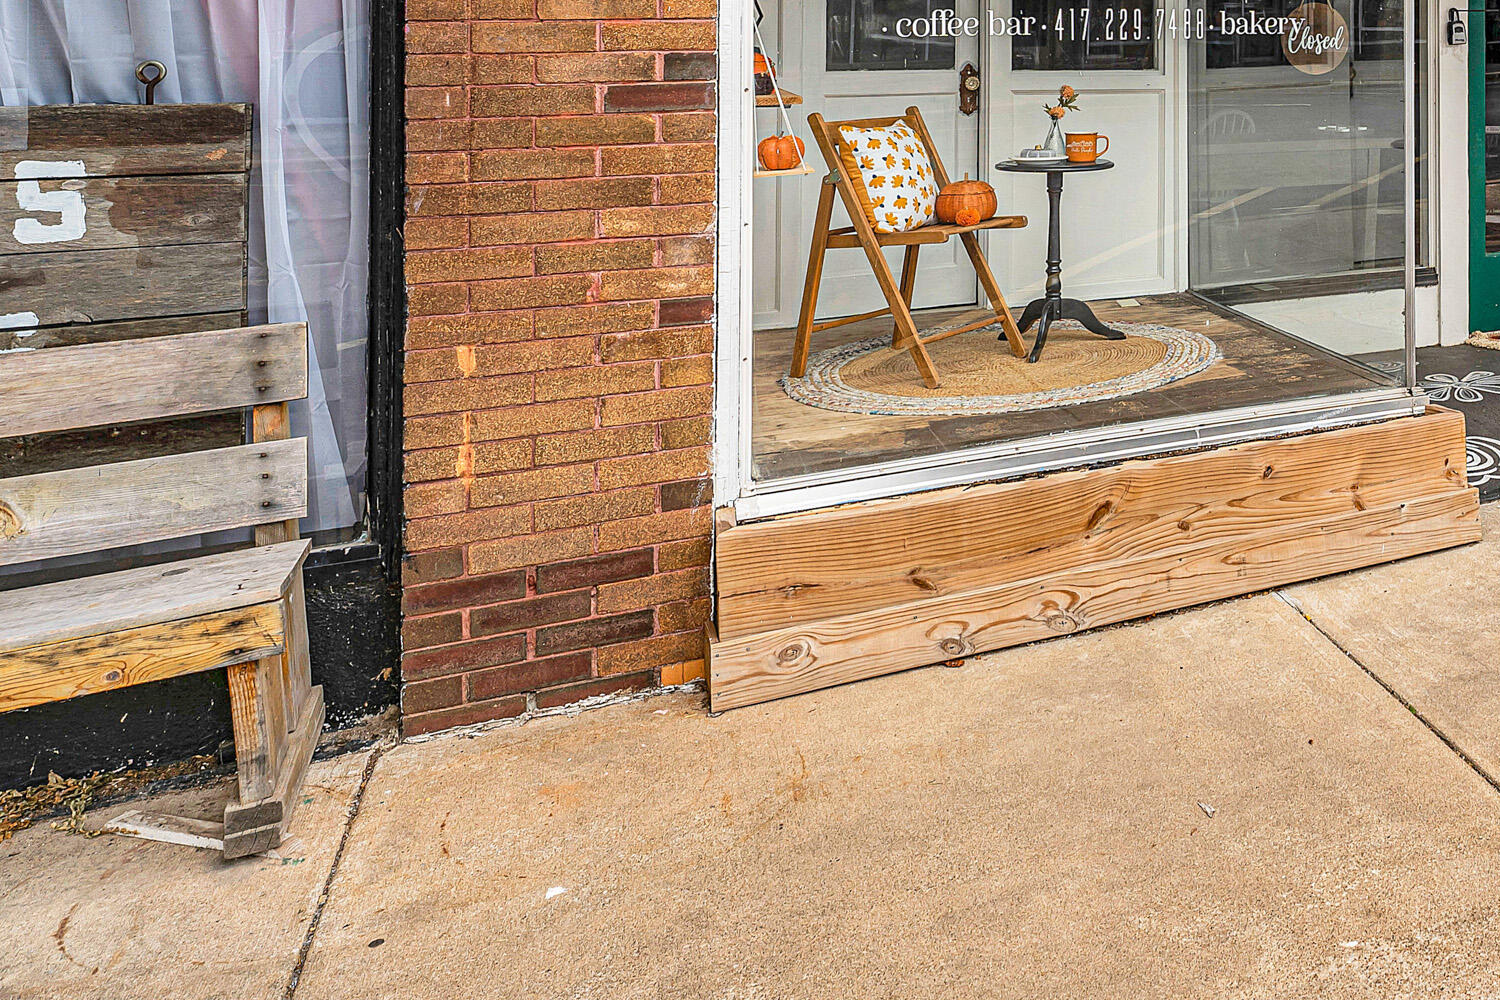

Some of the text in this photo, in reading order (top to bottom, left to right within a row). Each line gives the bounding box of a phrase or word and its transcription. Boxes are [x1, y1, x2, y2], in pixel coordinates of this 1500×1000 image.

[896, 8, 1306, 41] coffee bar 417.229.7488 bakery
[1288, 24, 1344, 54] Closed
